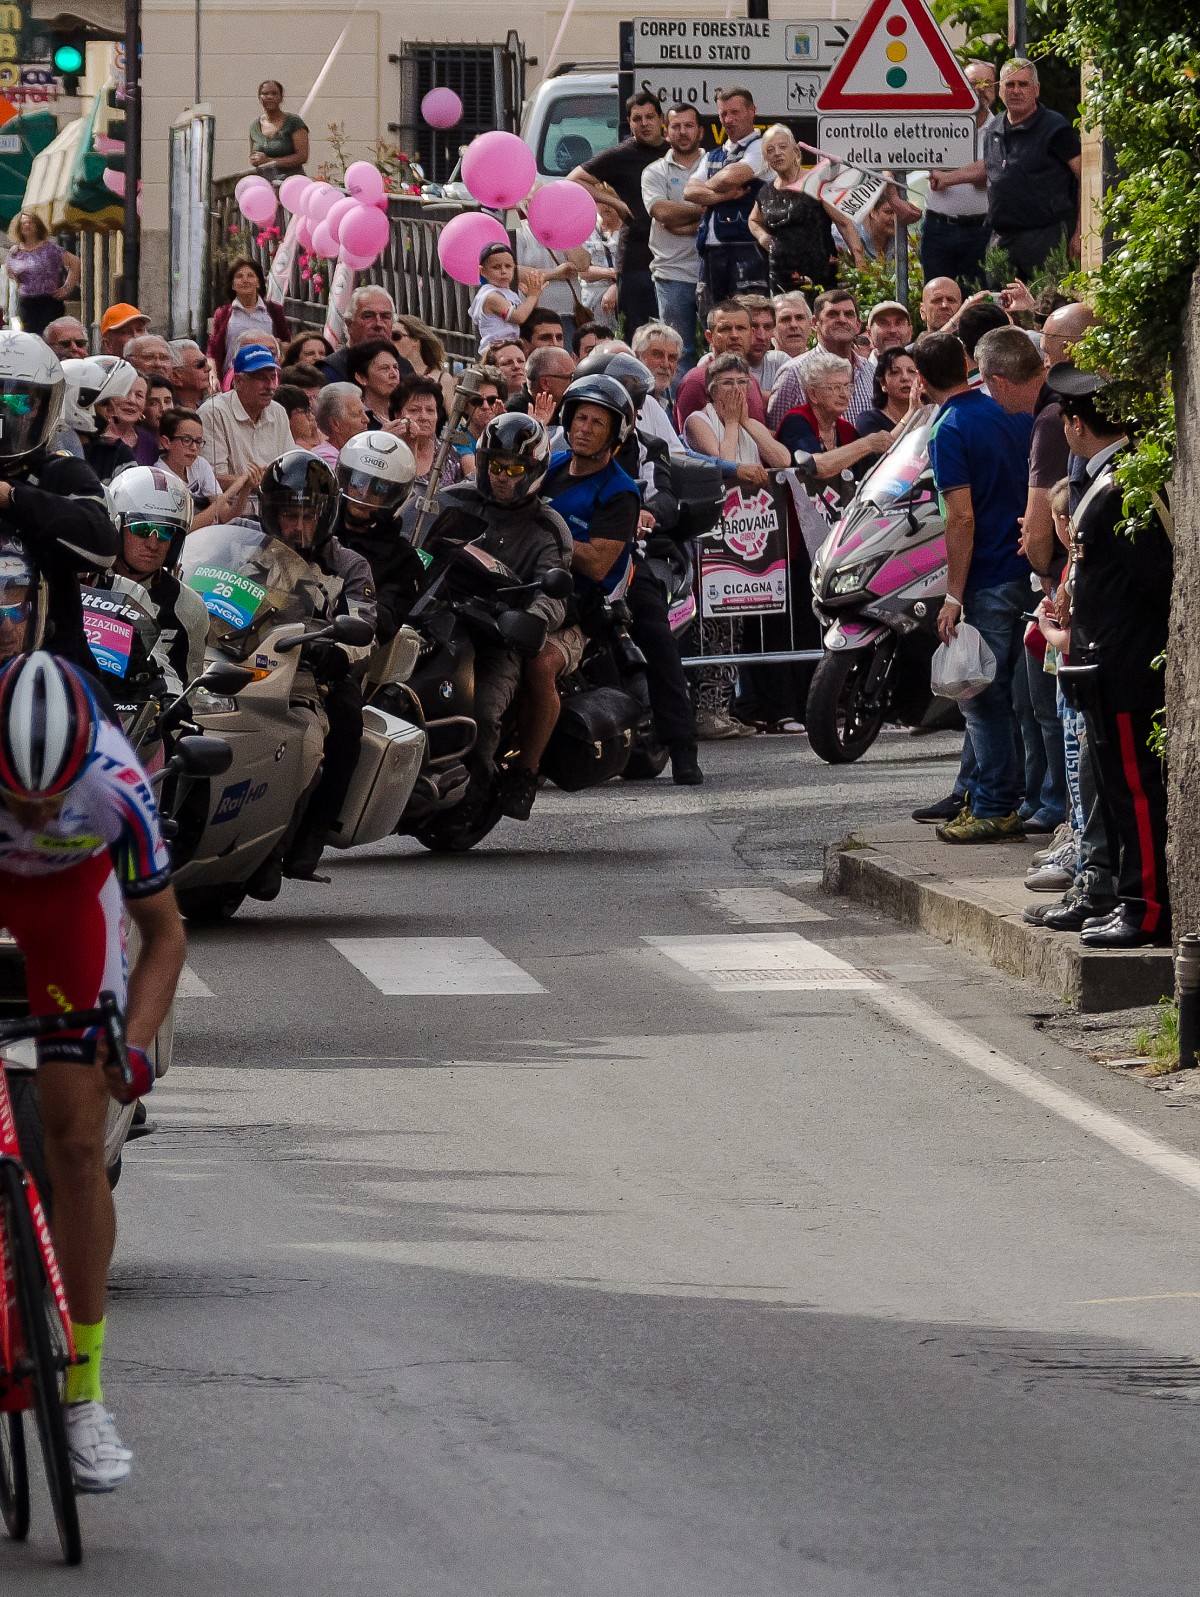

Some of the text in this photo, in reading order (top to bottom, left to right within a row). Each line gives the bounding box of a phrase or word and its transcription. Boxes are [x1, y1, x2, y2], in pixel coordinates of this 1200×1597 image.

[640, 21, 770, 38] CORPO FORESTALE
[660, 44, 750, 61] DELLO STATO
[825, 122, 969, 139] controllo elettronico
[847, 147, 882, 163] della
[364, 456, 386, 469] SHOEI
[715, 513, 776, 535] AROVANA
[194, 566, 265, 601] BROADCASTER
[212, 582, 234, 598] 26
[723, 581, 773, 595] CICAGNA
[80, 592, 141, 622] ittoria
[83, 615, 131, 639] IZZAZIONE
[219, 791, 246, 814] Rai
